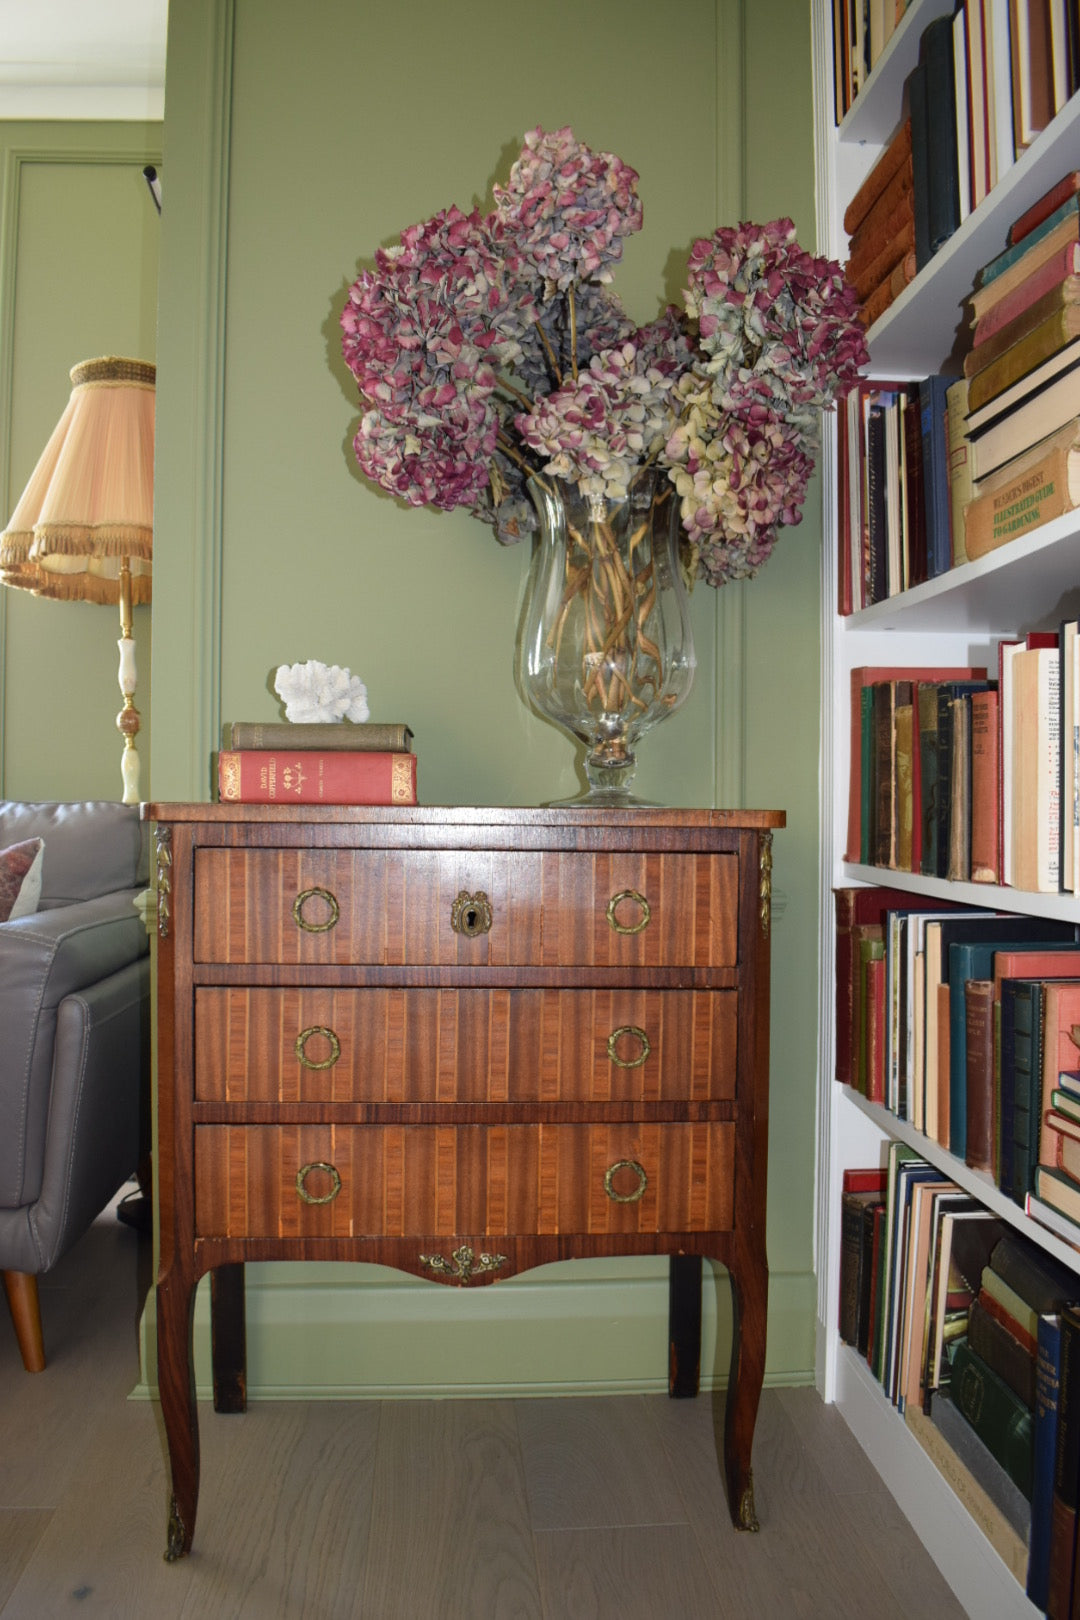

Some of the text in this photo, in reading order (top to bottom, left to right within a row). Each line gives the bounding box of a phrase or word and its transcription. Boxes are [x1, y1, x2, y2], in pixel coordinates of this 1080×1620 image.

[994, 470, 1044, 510] READER'S DIGEST
[994, 481, 1055, 525] ILLUSTRATED GUIDE
[993, 508, 1040, 539] TO GARDENING
[260, 766, 268, 789] DAVID
[268, 757, 276, 799] COPPERFIELD
